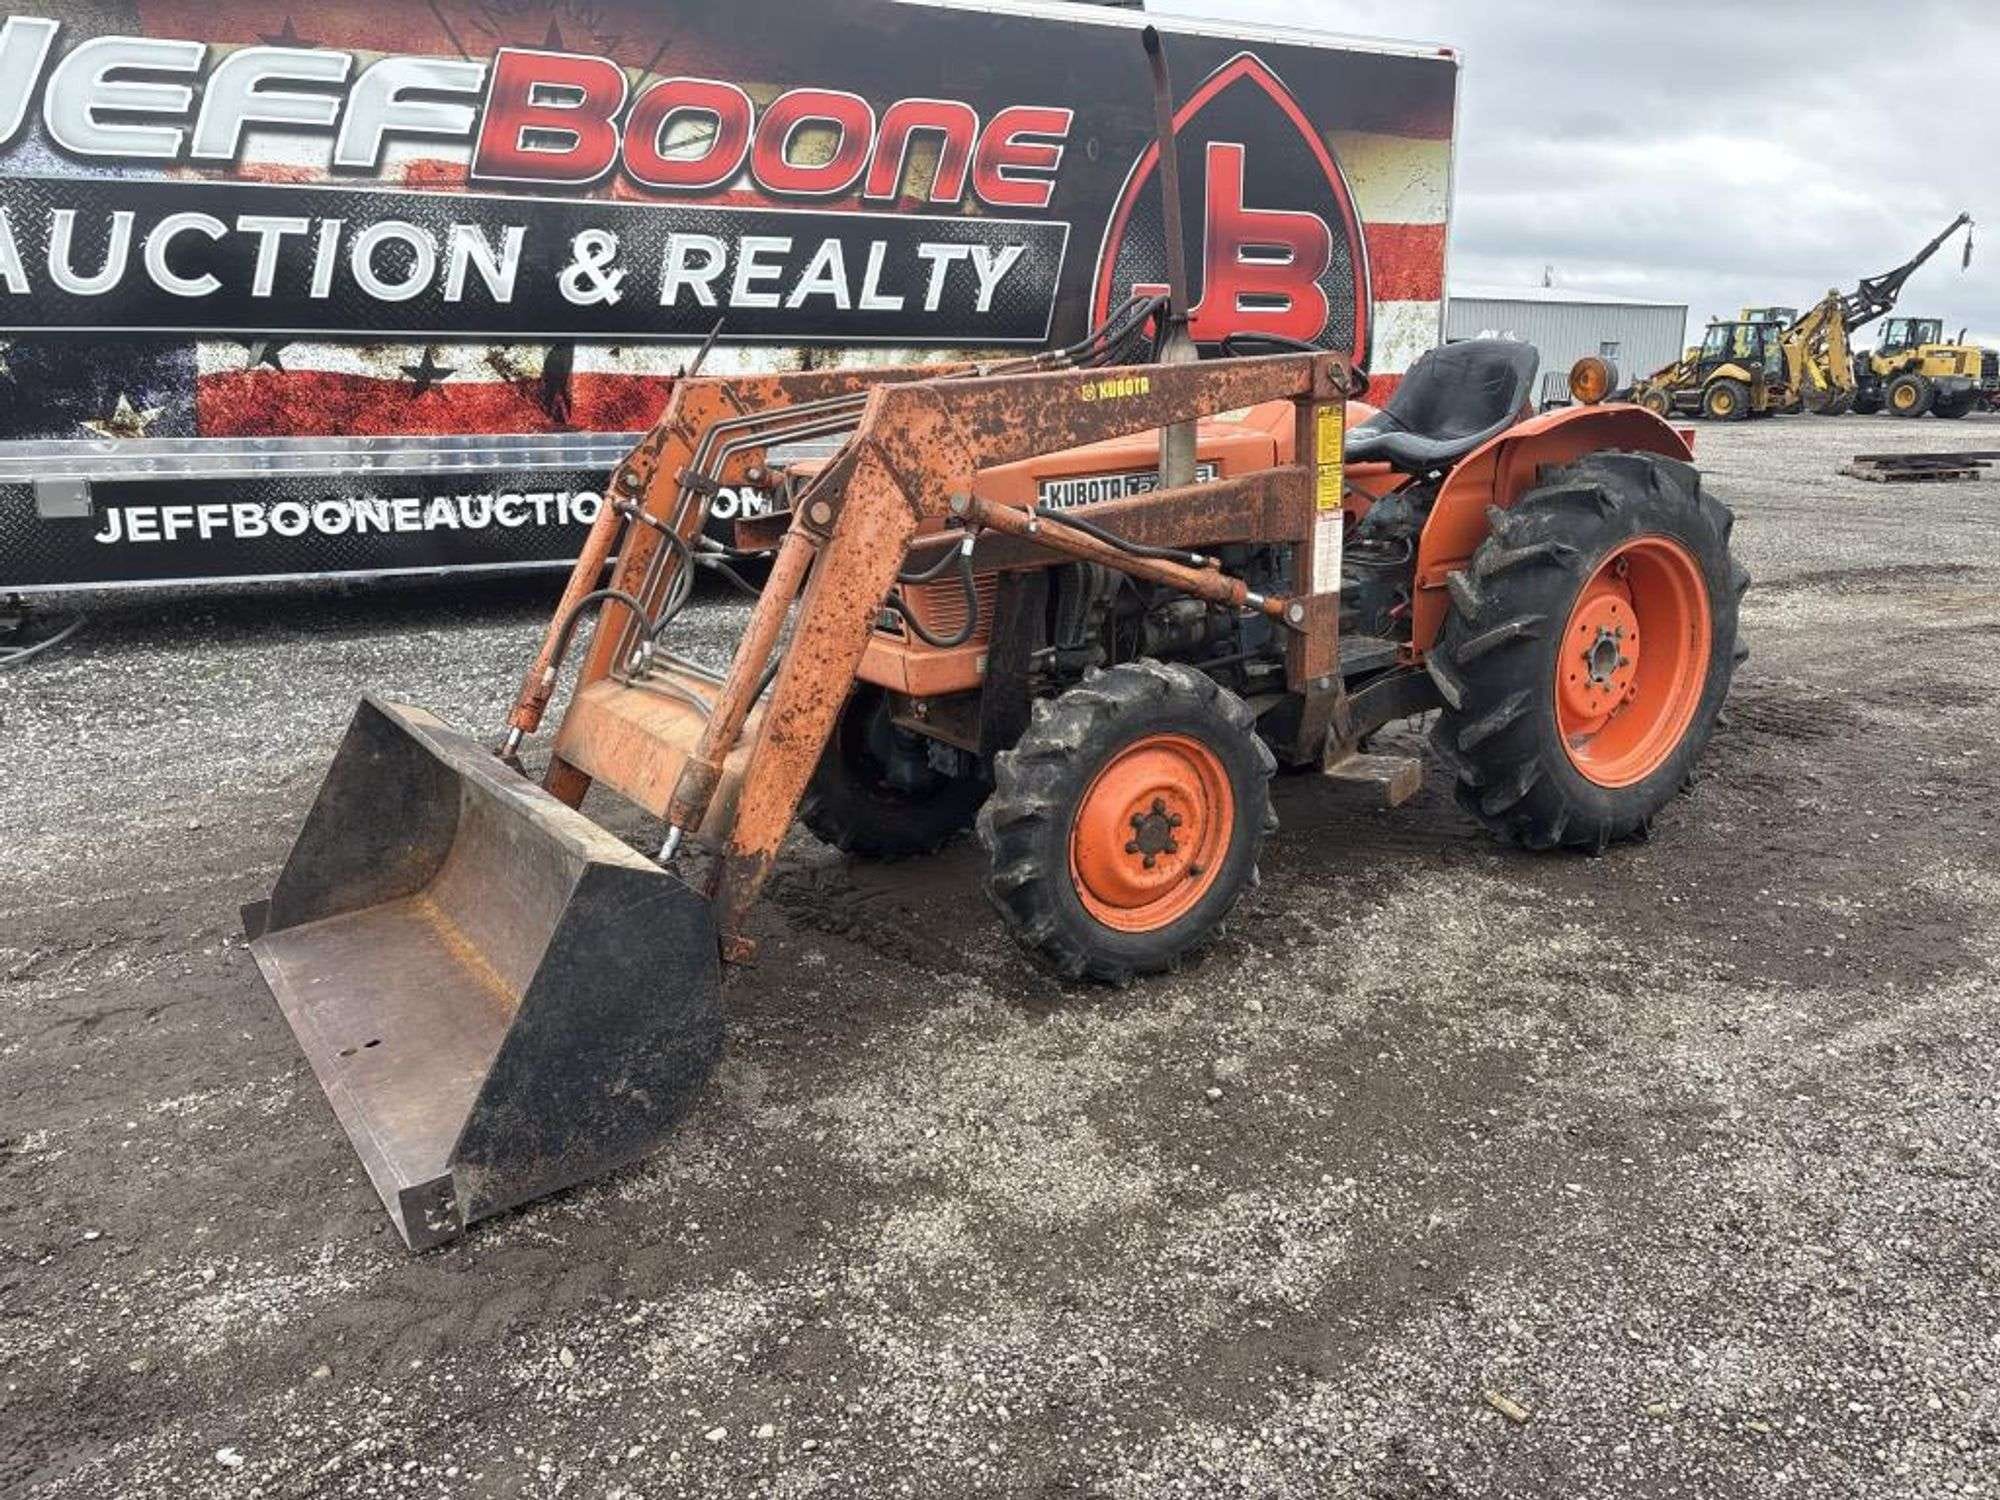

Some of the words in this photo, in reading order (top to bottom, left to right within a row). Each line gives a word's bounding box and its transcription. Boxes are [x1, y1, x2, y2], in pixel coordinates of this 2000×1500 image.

[558, 227, 624, 307] &
[659, 233, 1025, 313] REALTY
[1099, 376, 1150, 399] KUBOTA
[1049, 479, 1121, 508] KUBOTA
